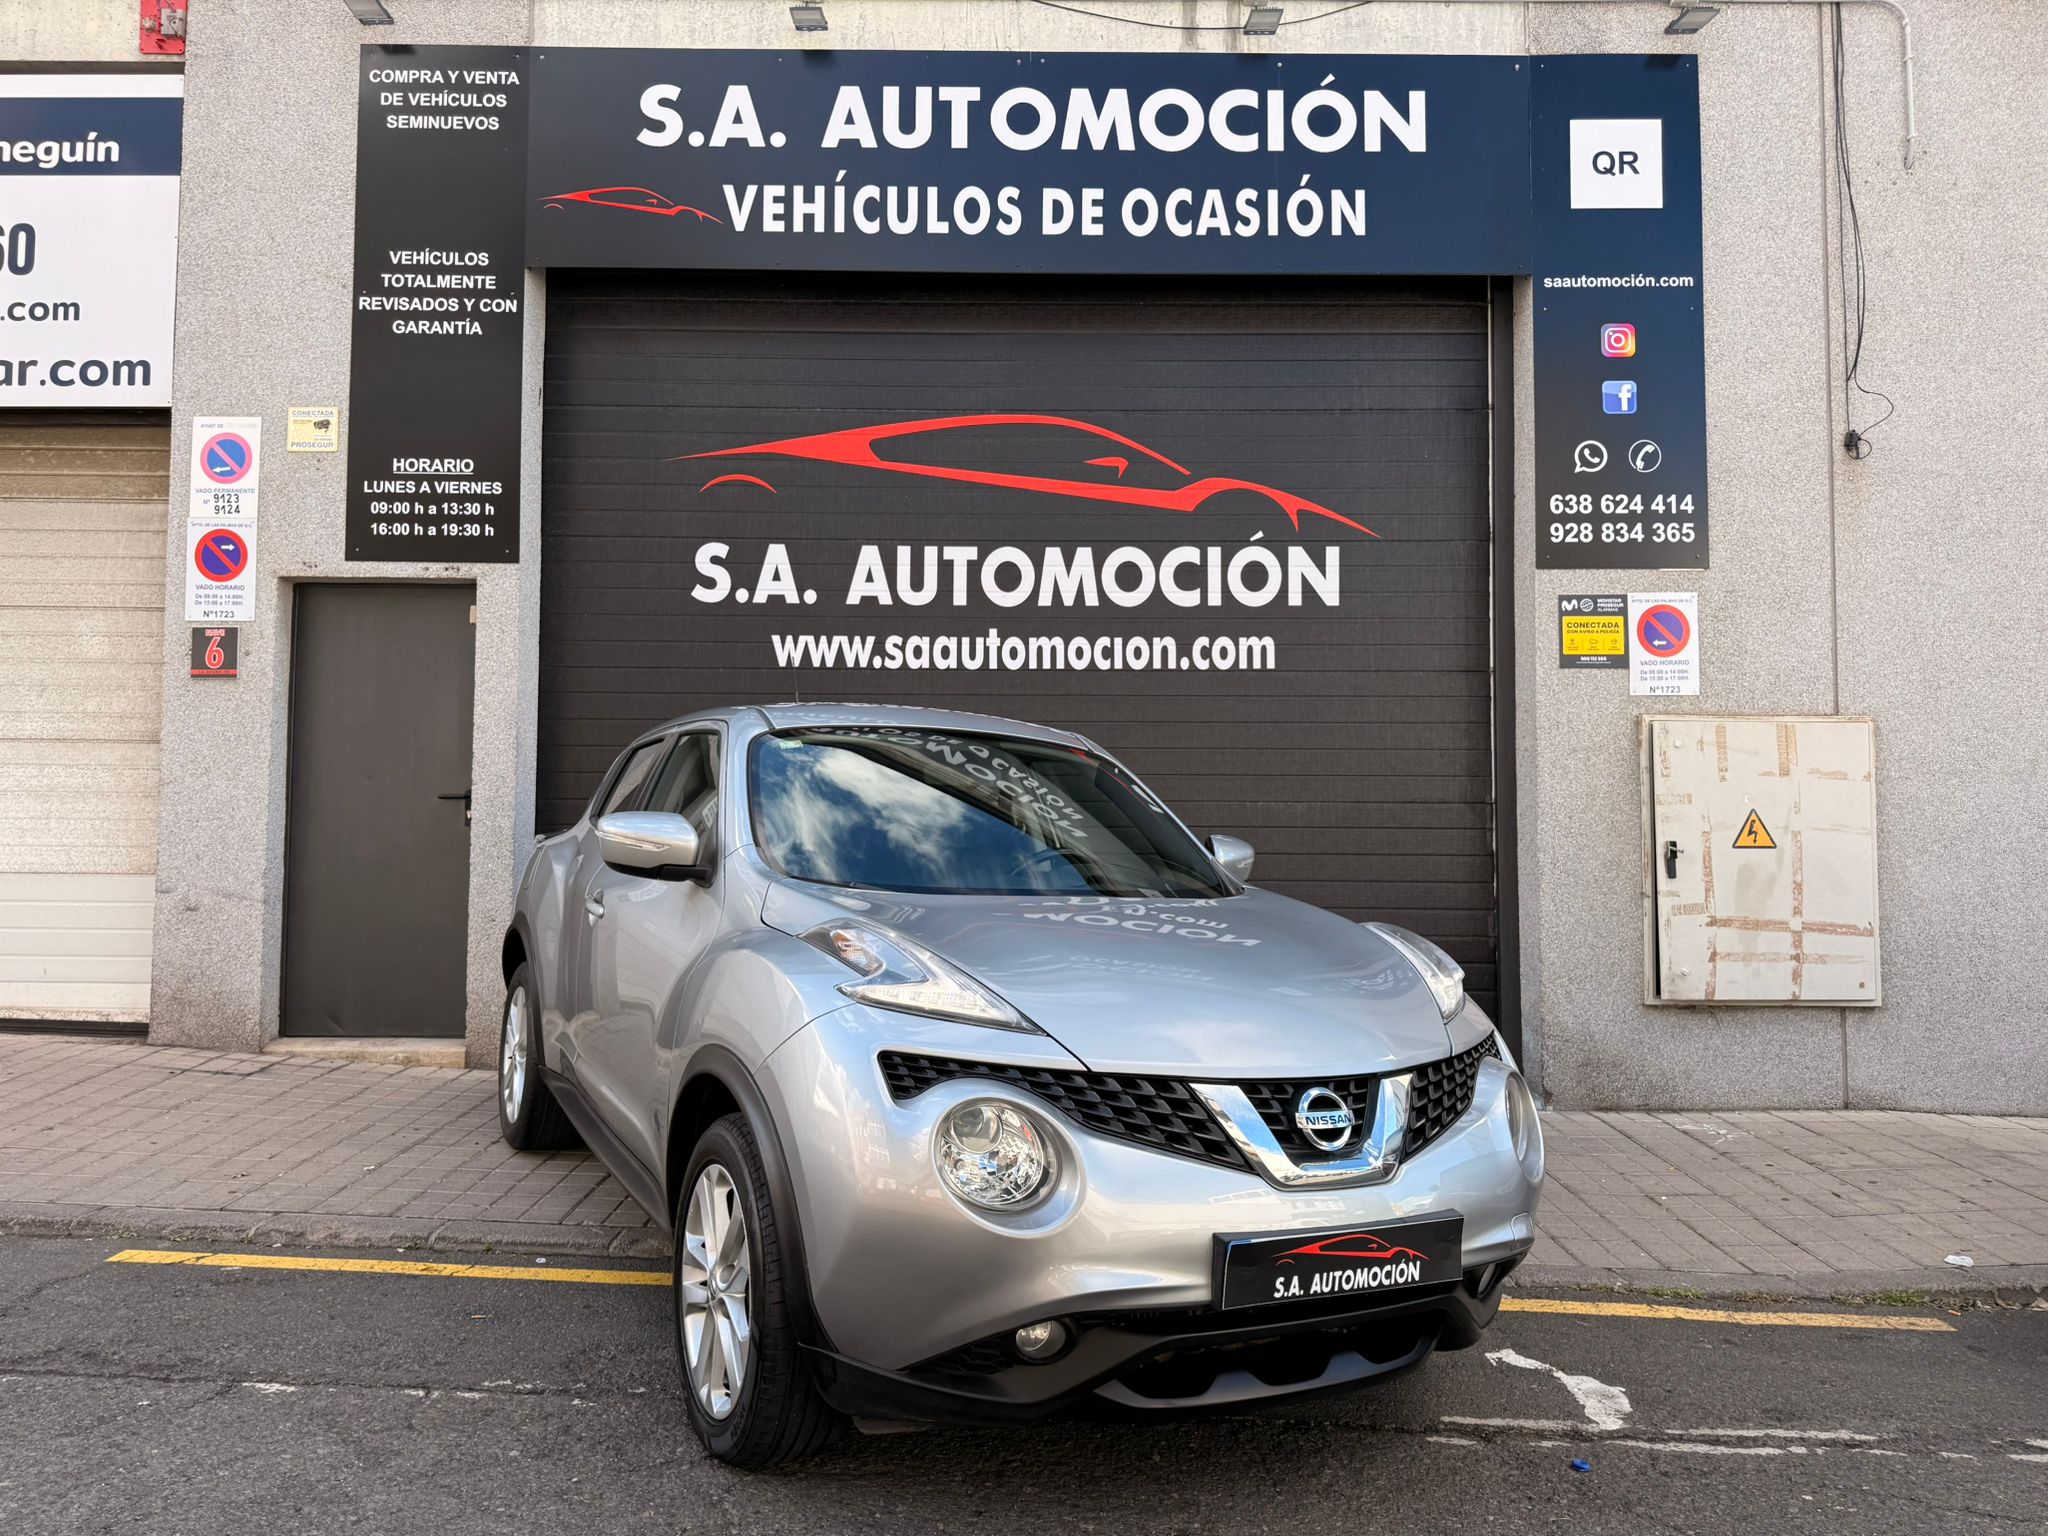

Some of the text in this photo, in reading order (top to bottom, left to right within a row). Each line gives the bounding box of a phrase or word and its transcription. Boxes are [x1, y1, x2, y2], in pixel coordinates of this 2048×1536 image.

[369, 70, 520, 85] COMPRA Y VENTA
[380, 90, 508, 108] DE VEHÍCULOS
[636, 73, 1428, 154] S.A. AUTOMOCIÓN
[386, 115, 500, 130] SEMINUEVOS
[1591, 150, 1640, 177] QR
[722, 169, 1368, 238] VEHÍCULOS DE OCASIÓN
[0, 222, 36, 276] 0
[389, 248, 489, 266] VEHÍCULOS
[381, 274, 497, 289] TOTALMENTE
[1543, 273, 1694, 289] saautomoción.com
[359, 297, 518, 313] REVISADOS Y CON
[392, 318, 482, 335] GARANTÍA
[393, 458, 474, 473] HORARIO
[363, 481, 503, 494] LUNES A VIERNES
[213, 493, 240, 504] 9123
[1549, 494, 1695, 515] 638 624 414
[214, 504, 240, 515] 9124
[370, 502, 495, 515] 09:00 h a 13:30 h
[370, 523, 494, 536] 16:00 h a 19:30 h
[1549, 522, 1696, 543] 928 834 365
[690, 530, 1341, 608] S.A. AUTOMOCIÓN
[204, 636, 225, 669] 6
[771, 628, 1276, 670] www.saautomocion.com
[1304, 1113, 1352, 1127] NISSAN
[1273, 1258, 1421, 1298] S.A. AUTOMOCIÓN
